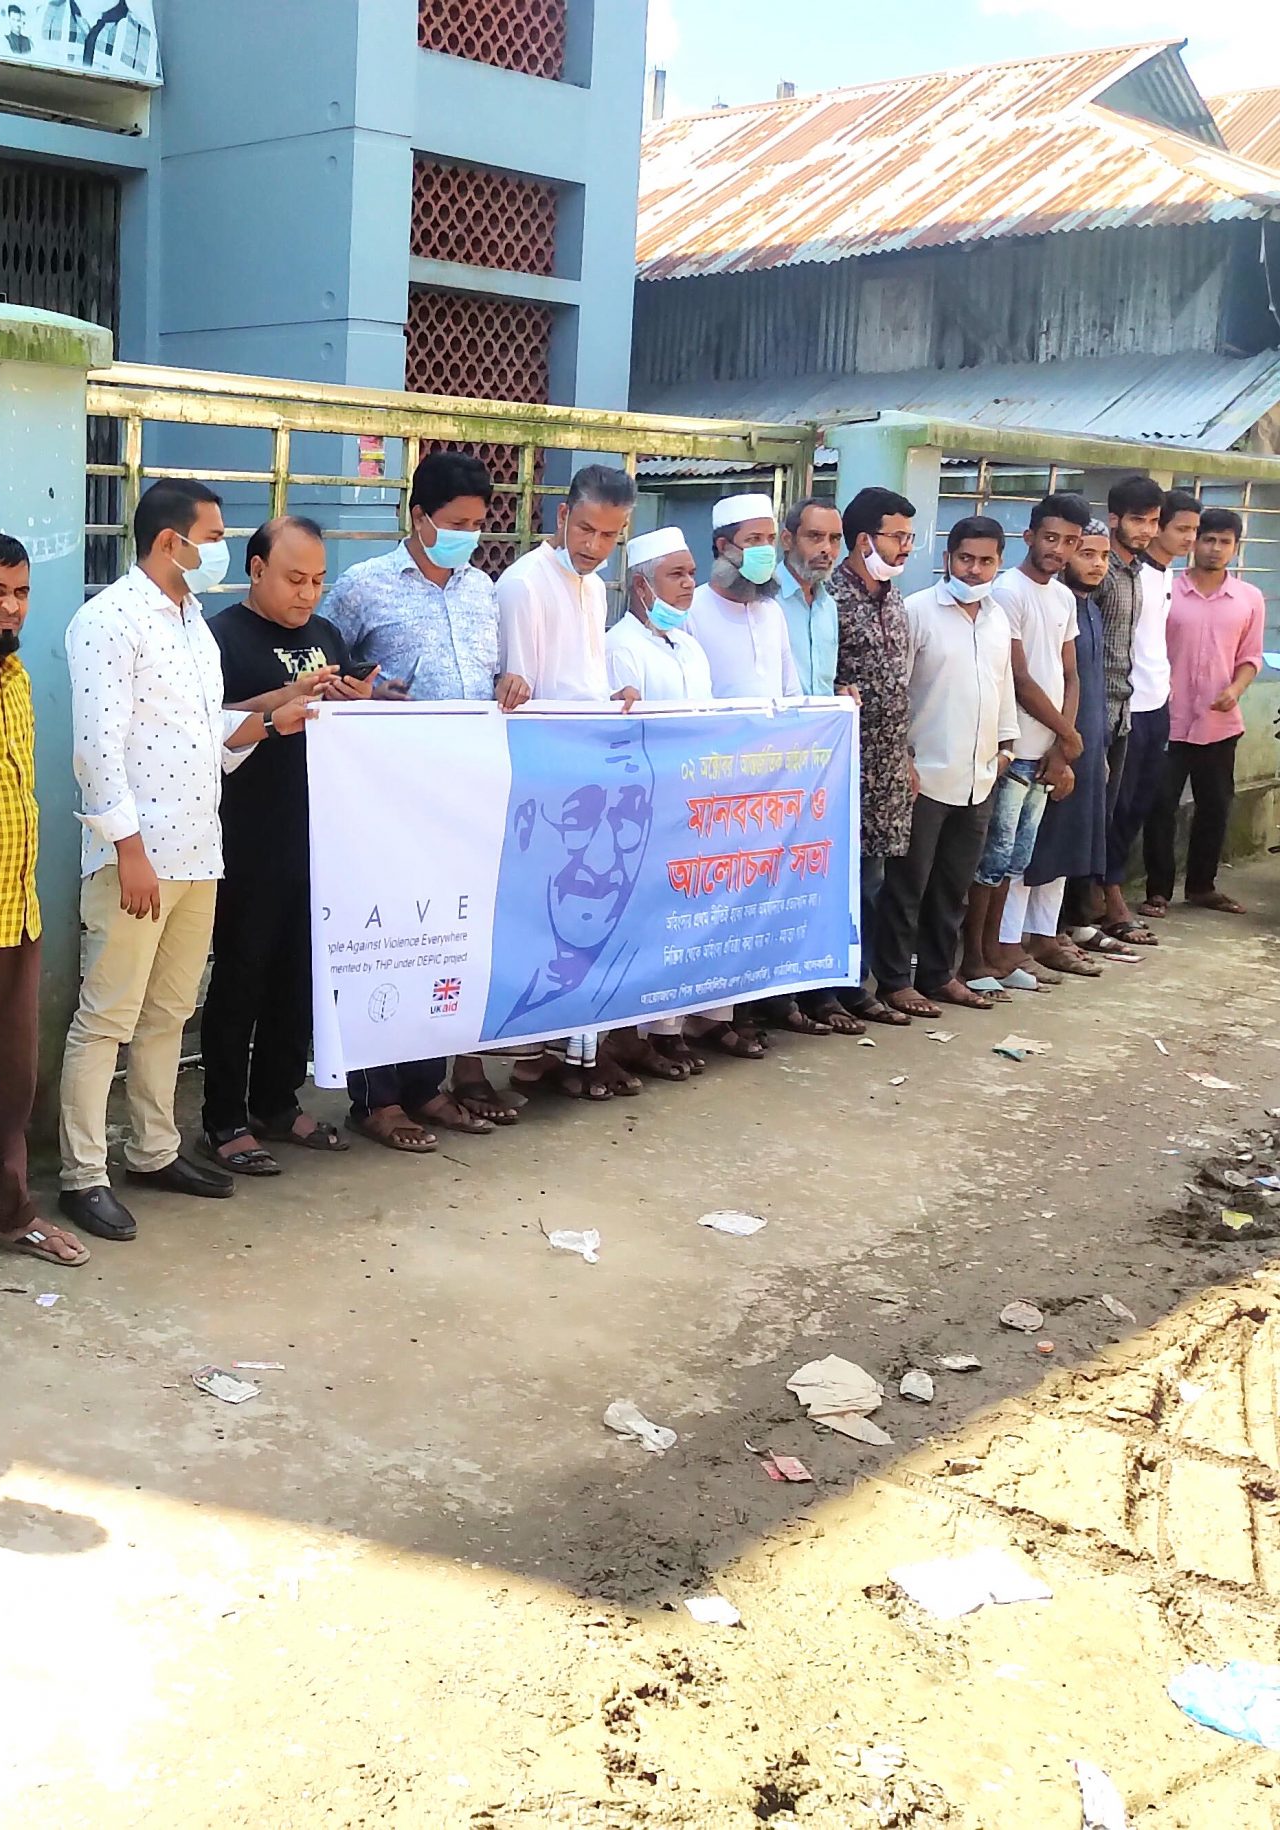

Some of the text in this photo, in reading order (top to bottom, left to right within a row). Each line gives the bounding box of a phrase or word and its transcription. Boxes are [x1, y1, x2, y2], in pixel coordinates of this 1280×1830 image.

[686, 787, 826, 838] মানববন্ধন ও
[666, 836, 833, 899] আলোচনা সভা
[328, 931, 468, 955] ple Against Violence Everywhere
[330, 963, 361, 974] mented
[363, 963, 373, 974] by
[376, 959, 393, 970] THP
[394, 958, 415, 969] under
[443, 952, 468, 966] project
